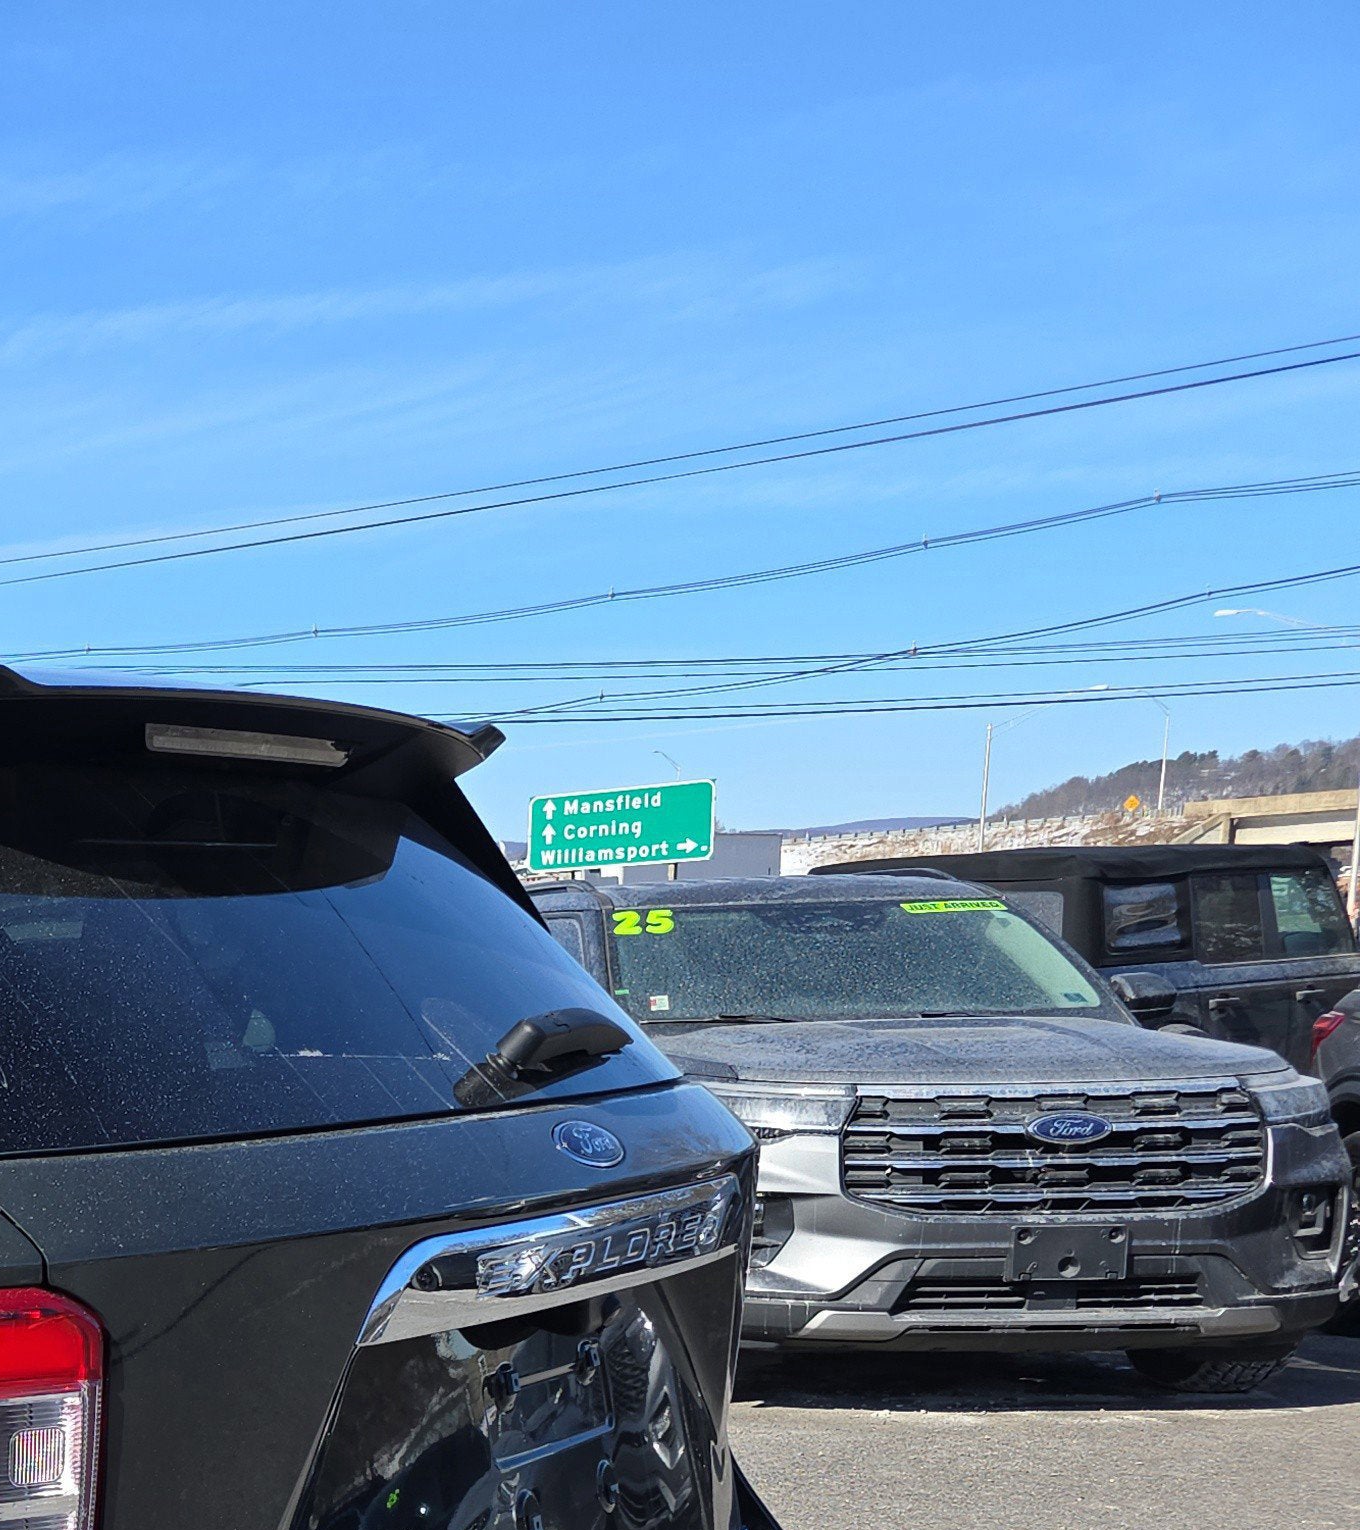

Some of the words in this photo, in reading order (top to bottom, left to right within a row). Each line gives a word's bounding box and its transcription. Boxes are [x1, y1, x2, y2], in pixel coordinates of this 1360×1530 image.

[563, 791, 662, 816] Mansfield
[563, 819, 642, 839] Corning
[540, 840, 669, 866] Williamsport
[612, 909, 675, 935] 25
[1049, 1118, 1094, 1137] Ford
